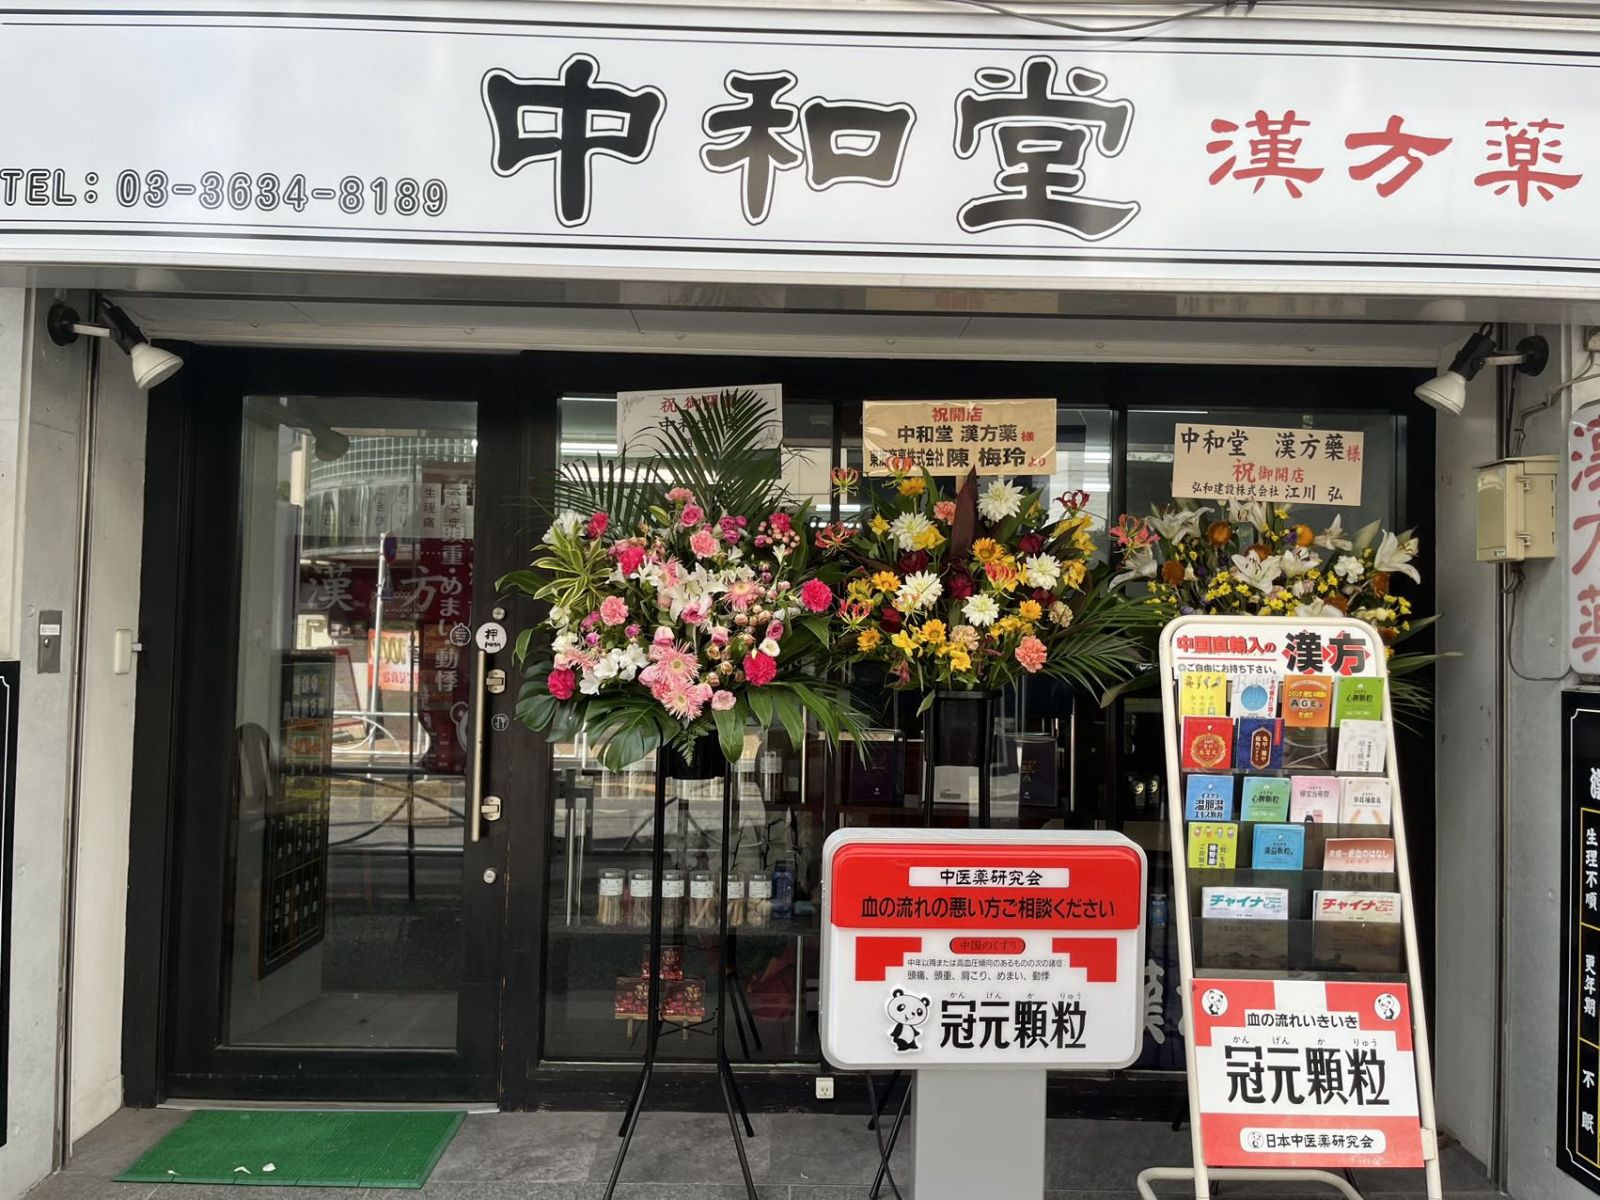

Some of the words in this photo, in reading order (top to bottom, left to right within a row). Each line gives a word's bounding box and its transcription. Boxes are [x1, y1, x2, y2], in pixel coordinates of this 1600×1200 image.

[482, 53, 1140, 241] 中和堂
[1205, 110, 1584, 206] 漢方薬
[116, 169, 448, 217] 03-3634-8189
[931, 407, 983, 422] 祝開店
[898, 425, 953, 444] 中和堂
[961, 424, 1017, 443] 漢方薬
[1021, 431, 1034, 443] 様
[1181, 427, 1249, 457] 中和堂
[1346, 446, 1361, 463] 様
[947, 449, 969, 468] 陳
[979, 447, 1026, 468] 梅玲
[1191, 481, 1280, 498] 弘和建設株式会社
[1285, 484, 1317, 500] 江川
[1284, 630, 1371, 675] 漢方
[940, 868, 1043, 887] 中医薬研究会
[861, 896, 1115, 919] 血の流れの悪い方ご相談ください
[1211, 894, 1264, 908] チャイナ
[1323, 898, 1376, 911] チャイナ
[960, 940, 1016, 951] 中国のくすり
[1584, 954, 1596, 1018] 更年期
[940, 1000, 1087, 1049] 冠元顆粒
[1247, 1012, 1358, 1029] 血の流れいきいき
[1225, 1045, 1390, 1105] 冠元顆粒
[1266, 1133, 1374, 1149] 日本中医薬研究会
